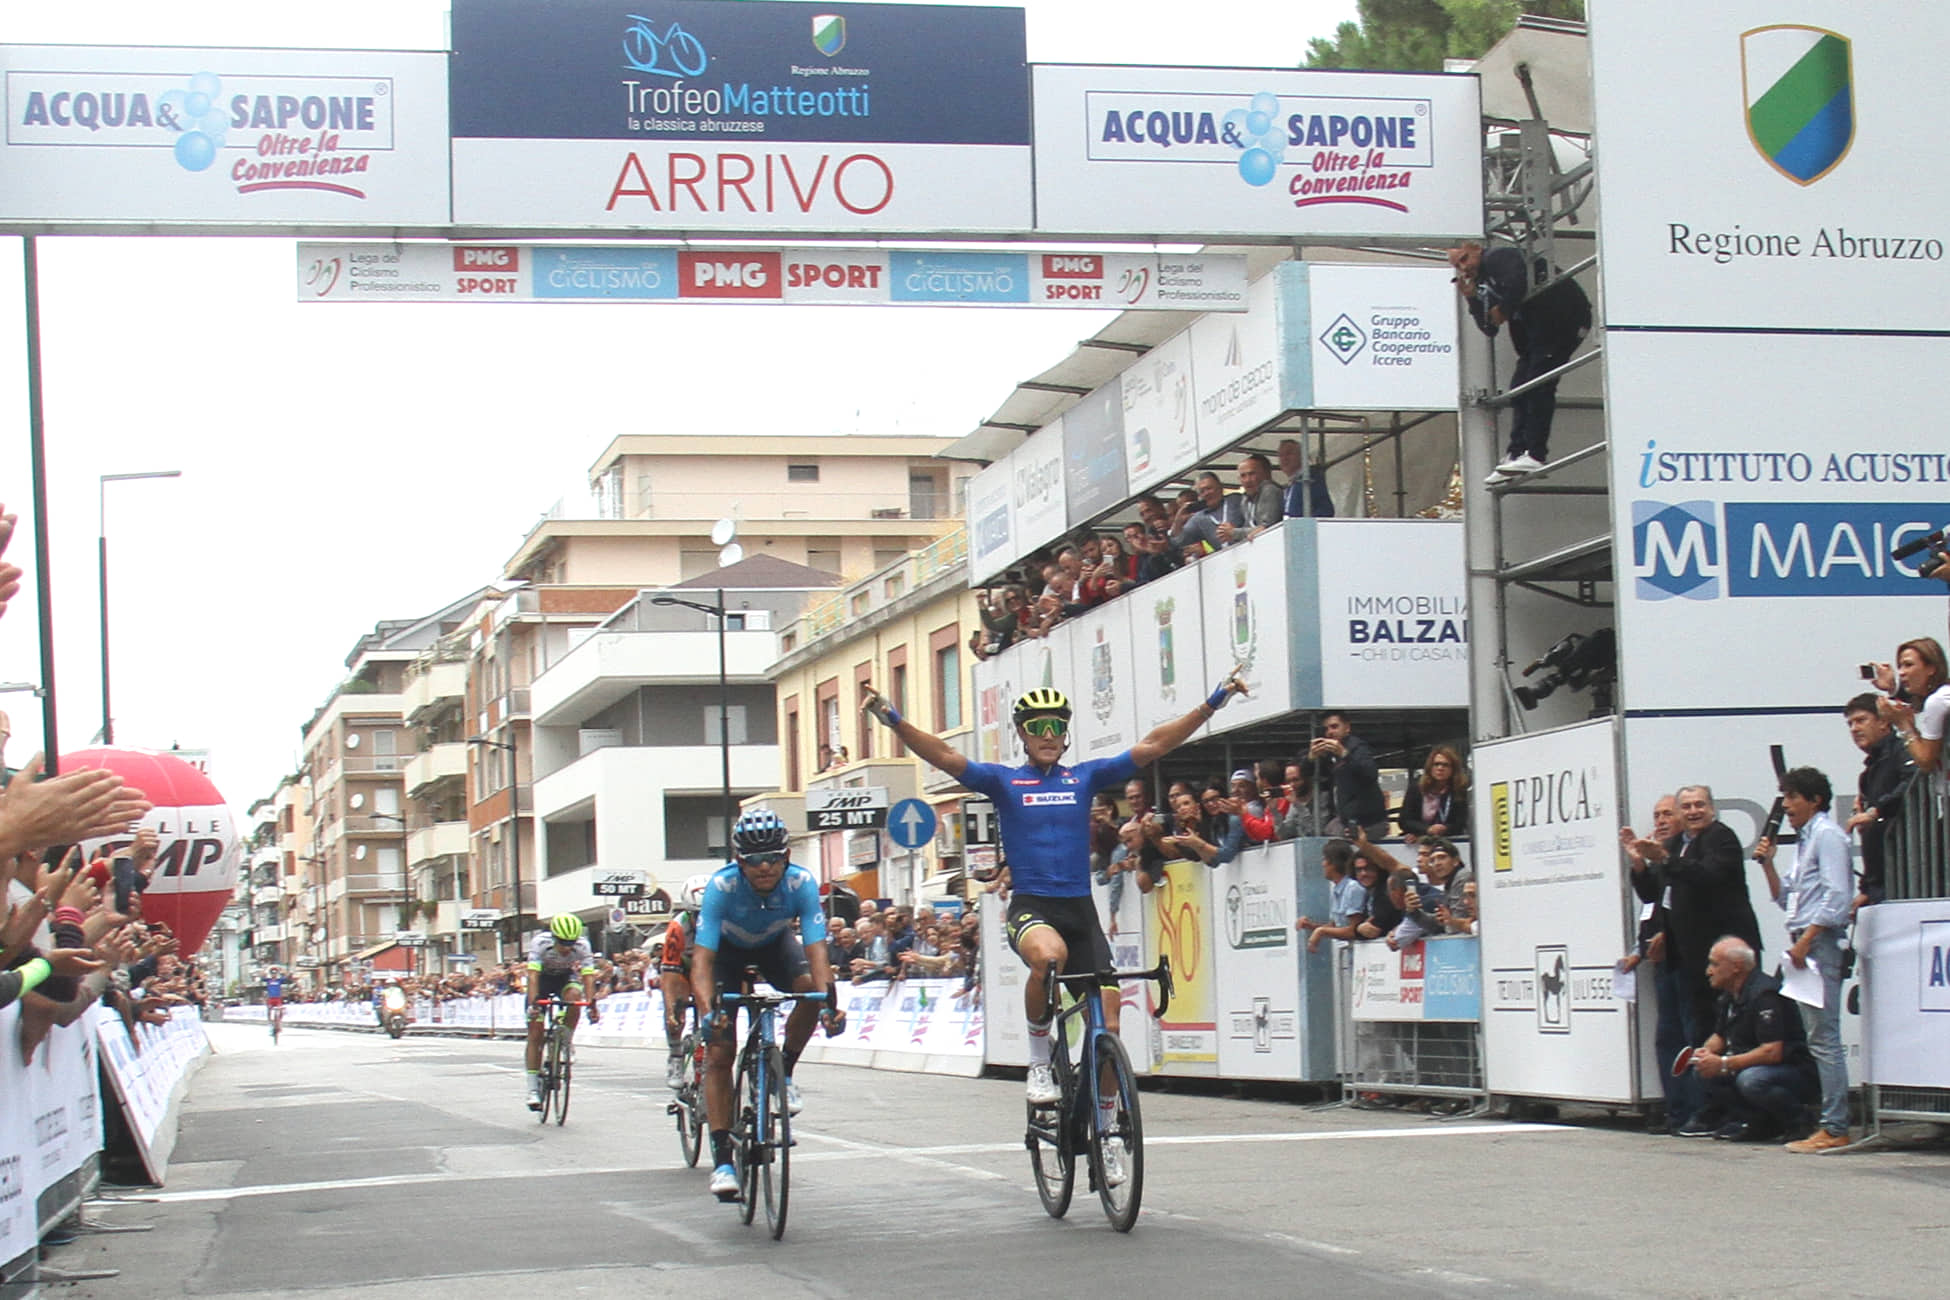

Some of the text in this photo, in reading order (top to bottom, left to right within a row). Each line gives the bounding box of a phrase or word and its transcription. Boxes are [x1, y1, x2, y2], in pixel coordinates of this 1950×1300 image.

[790, 65, 871, 77] Regione Abruzzo
[23, 91, 376, 131] ACQUA & SAPONE
[628, 116, 766, 133] la classica abruzzese
[1102, 110, 1417, 149] ACQUA & SAPONE
[256, 129, 341, 157] Oltre la
[231, 153, 371, 182] Convenienza
[1311, 148, 1386, 173] Oltre la
[605, 152, 895, 215] ARRIVO
[1288, 168, 1412, 197] Convenienza
[1666, 222, 1945, 264] Regione Abruzzo
[350, 252, 379, 265] Lega
[463, 250, 510, 266] PMG
[1051, 257, 1095, 273] PMG
[350, 266, 400, 278] Ciclismo
[694, 261, 768, 288] PMG
[787, 262, 883, 289] SPORT
[1157, 263, 1204, 275] Lega del
[350, 280, 441, 293] Professionistico
[456, 278, 518, 294] SPORT
[1157, 276, 1203, 287] Ciclismo
[1045, 284, 1104, 300] SPORT
[1157, 289, 1241, 301] Professionistico
[1370, 314, 1420, 329] Gruppo
[1371, 328, 1431, 341] Bancario
[1371, 340, 1452, 356] Cooperativo
[1372, 355, 1413, 366] Iccrea
[1820, 452, 1950, 483] ACUSTI
[1748, 521, 1950, 578] MAIC
[1349, 619, 1469, 643] BALZA
[1409, 647, 1452, 661] CASA
[821, 796, 873, 809] SMP
[1512, 768, 1592, 829] EPICA
[818, 810, 877, 827] 25 MT
[965, 802, 994, 842] T
[599, 884, 638, 894] 50 MT
